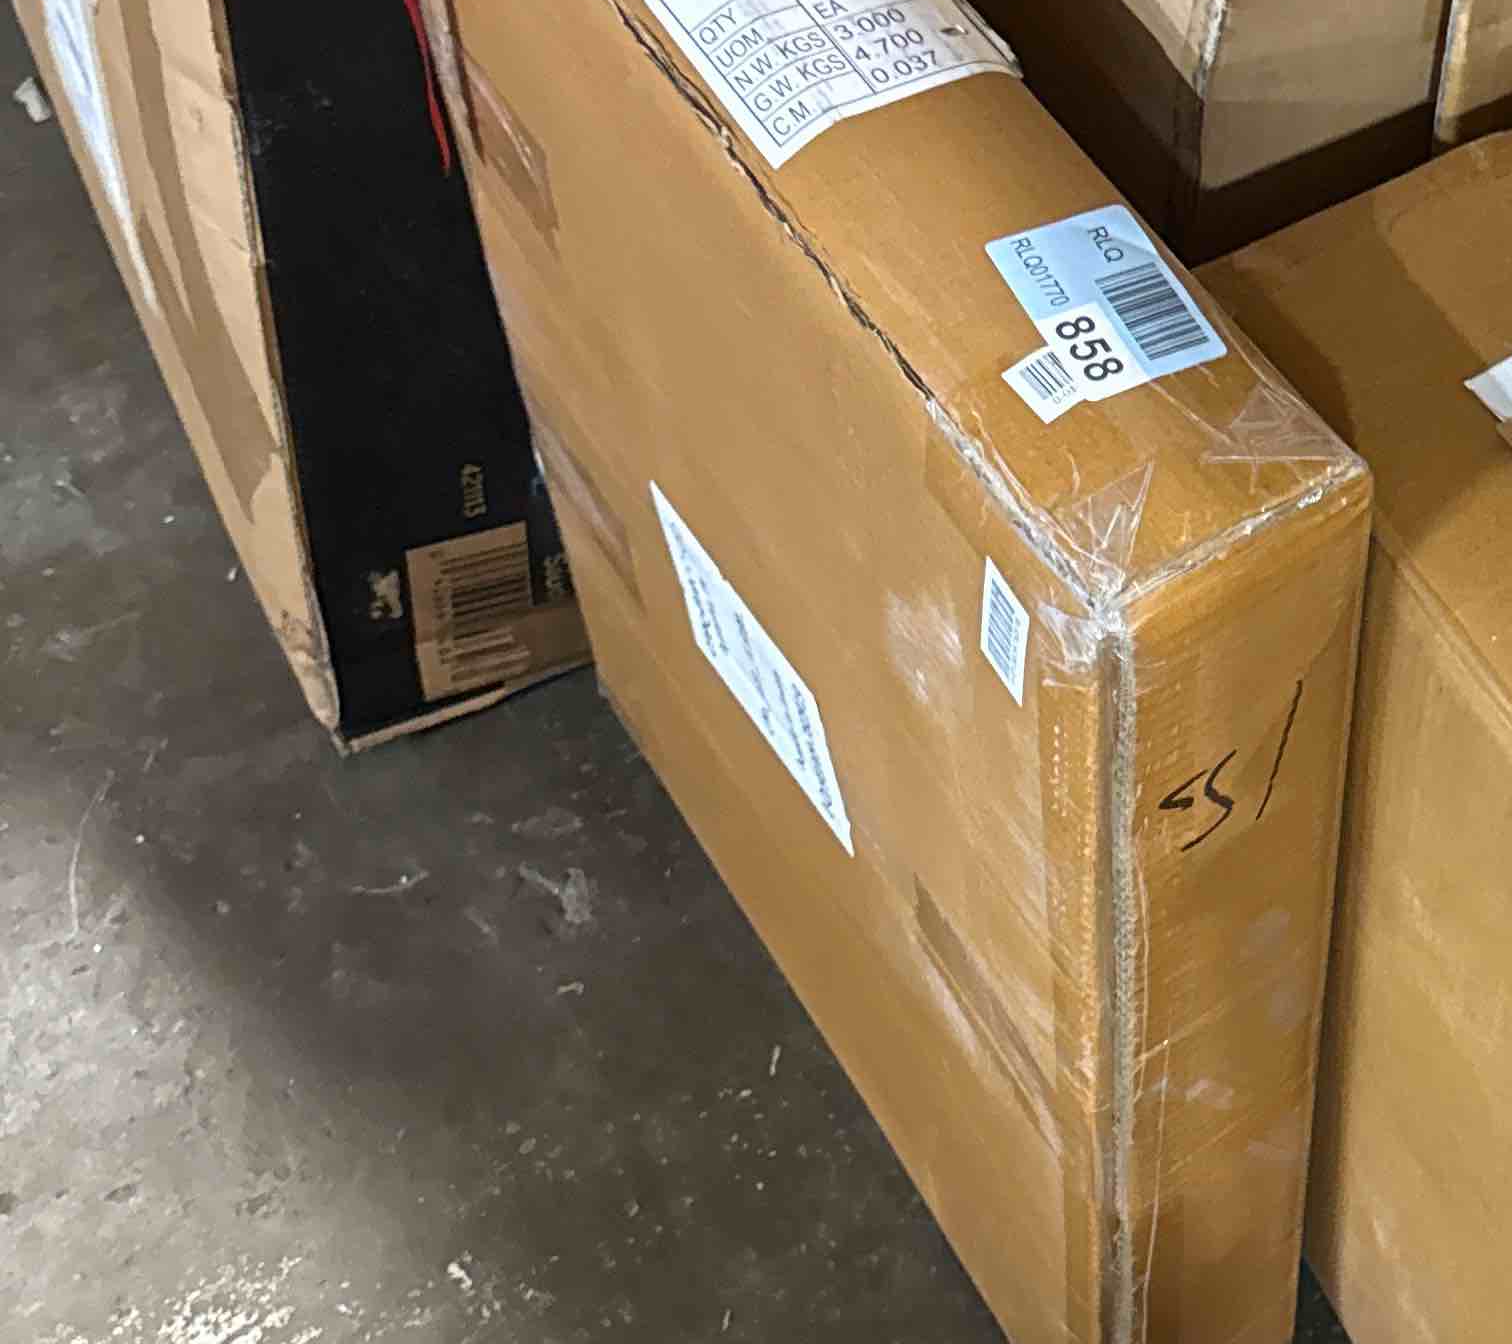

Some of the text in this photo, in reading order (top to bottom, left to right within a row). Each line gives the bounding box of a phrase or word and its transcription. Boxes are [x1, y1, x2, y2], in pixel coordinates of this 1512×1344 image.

[697, 0, 849, 47] QTY EA
[715, 26, 766, 69] UOM
[773, 30, 828, 61] KGS
[832, 7, 907, 42] 3.000
[795, 53, 848, 83] KGS
[854, 27, 925, 63] 4.700
[870, 48, 941, 85] 0.037
[1086, 224, 1125, 264] RLQ
[1008, 235, 1071, 308] RLQ01770
[1054, 314, 1126, 384] 858
